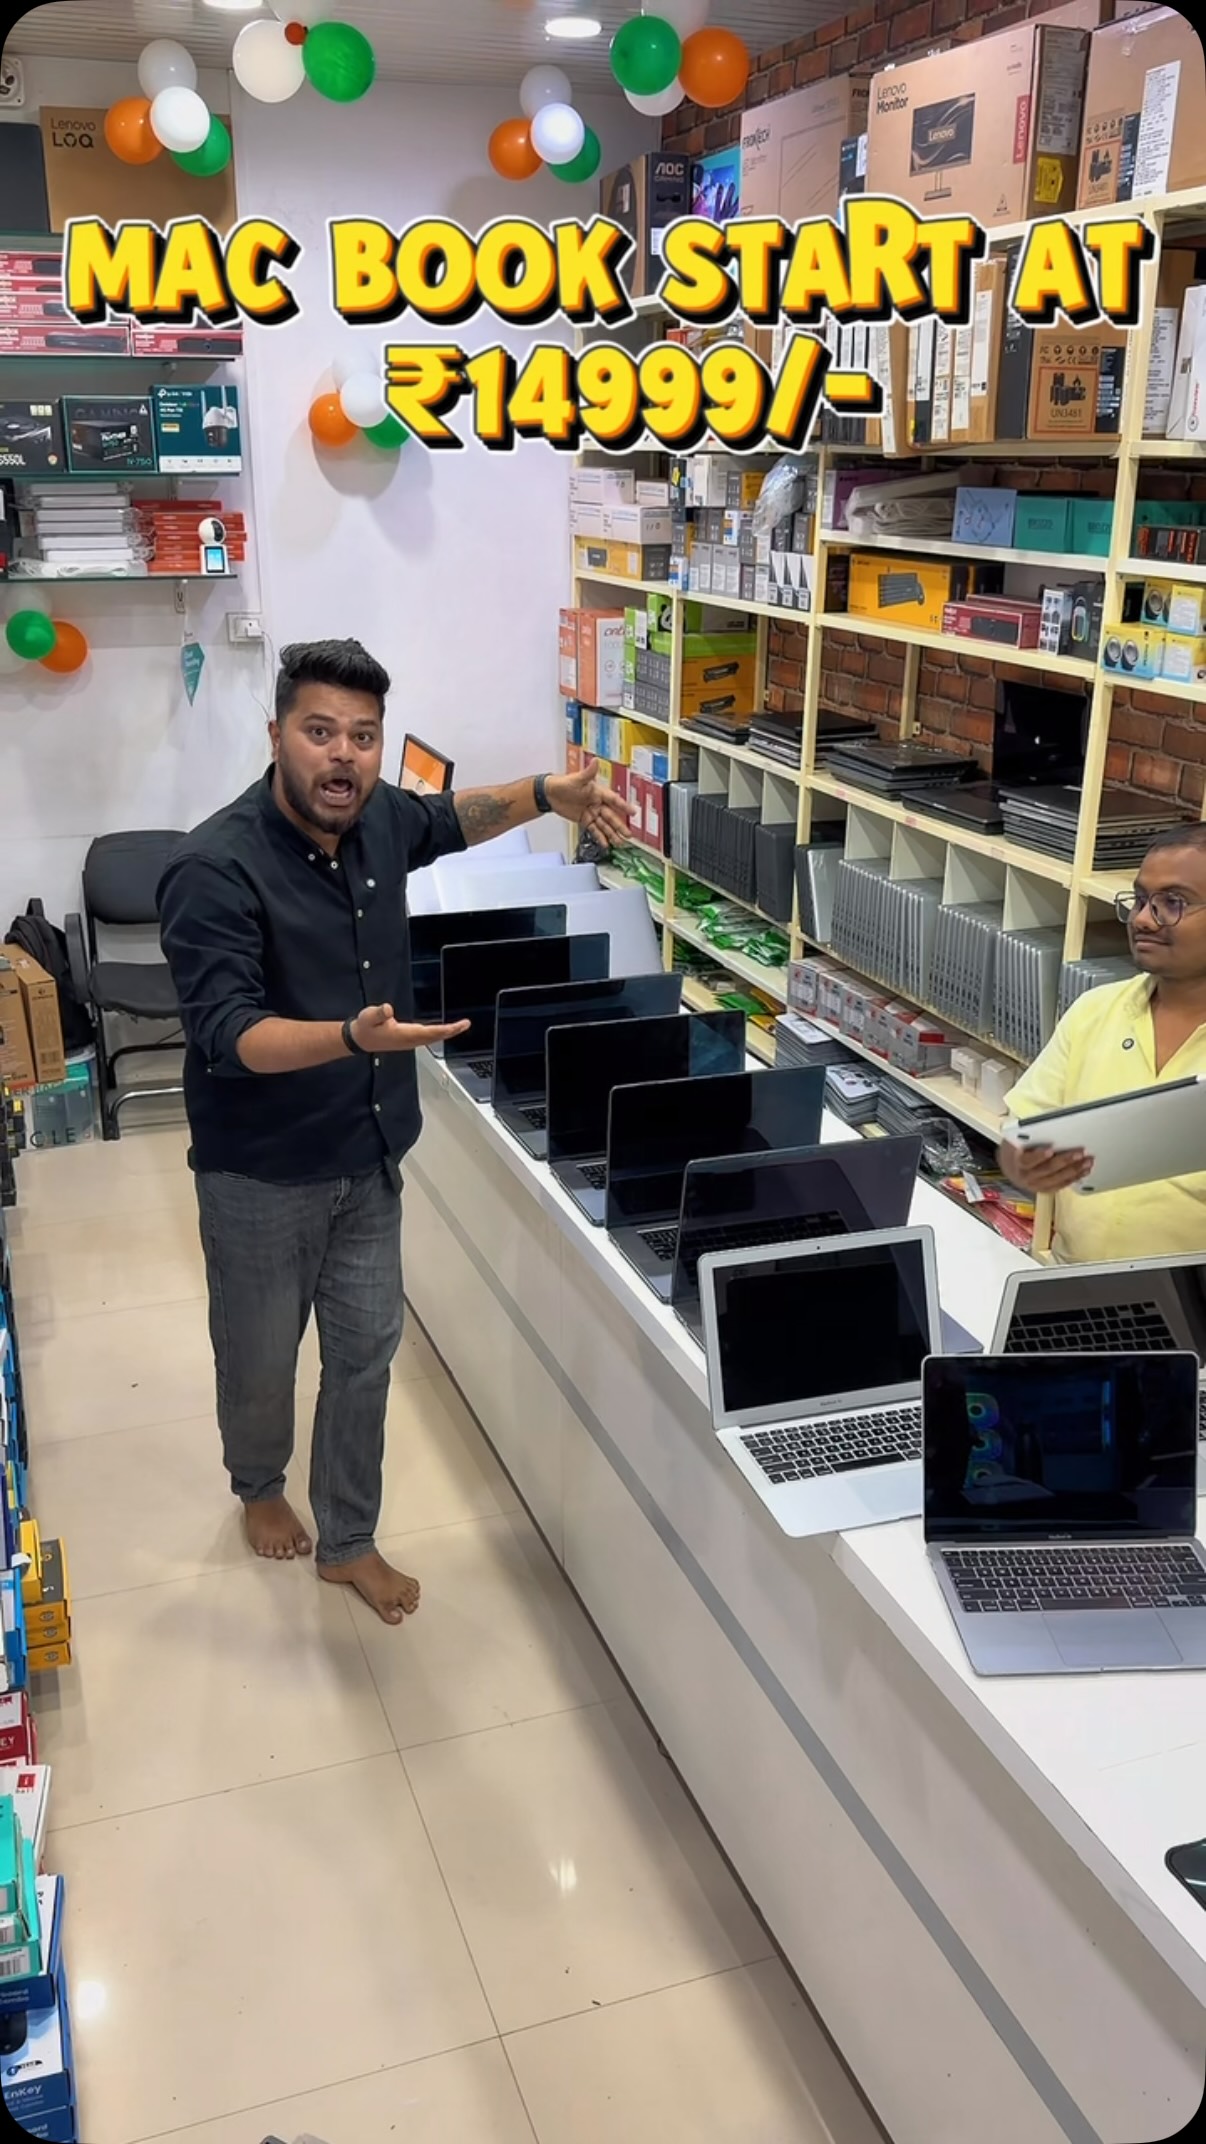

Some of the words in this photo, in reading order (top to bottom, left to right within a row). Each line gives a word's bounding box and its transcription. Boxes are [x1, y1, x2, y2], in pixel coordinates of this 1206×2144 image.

[877, 82, 907, 100] Lenovo
[876, 96, 909, 115] Monitor
[50, 117, 97, 132] Lenovo
[1015, 101, 1028, 159] Lenovo
[52, 131, 95, 149] LOQ
[927, 126, 956, 142] Lenovo
[655, 161, 685, 176] AOC
